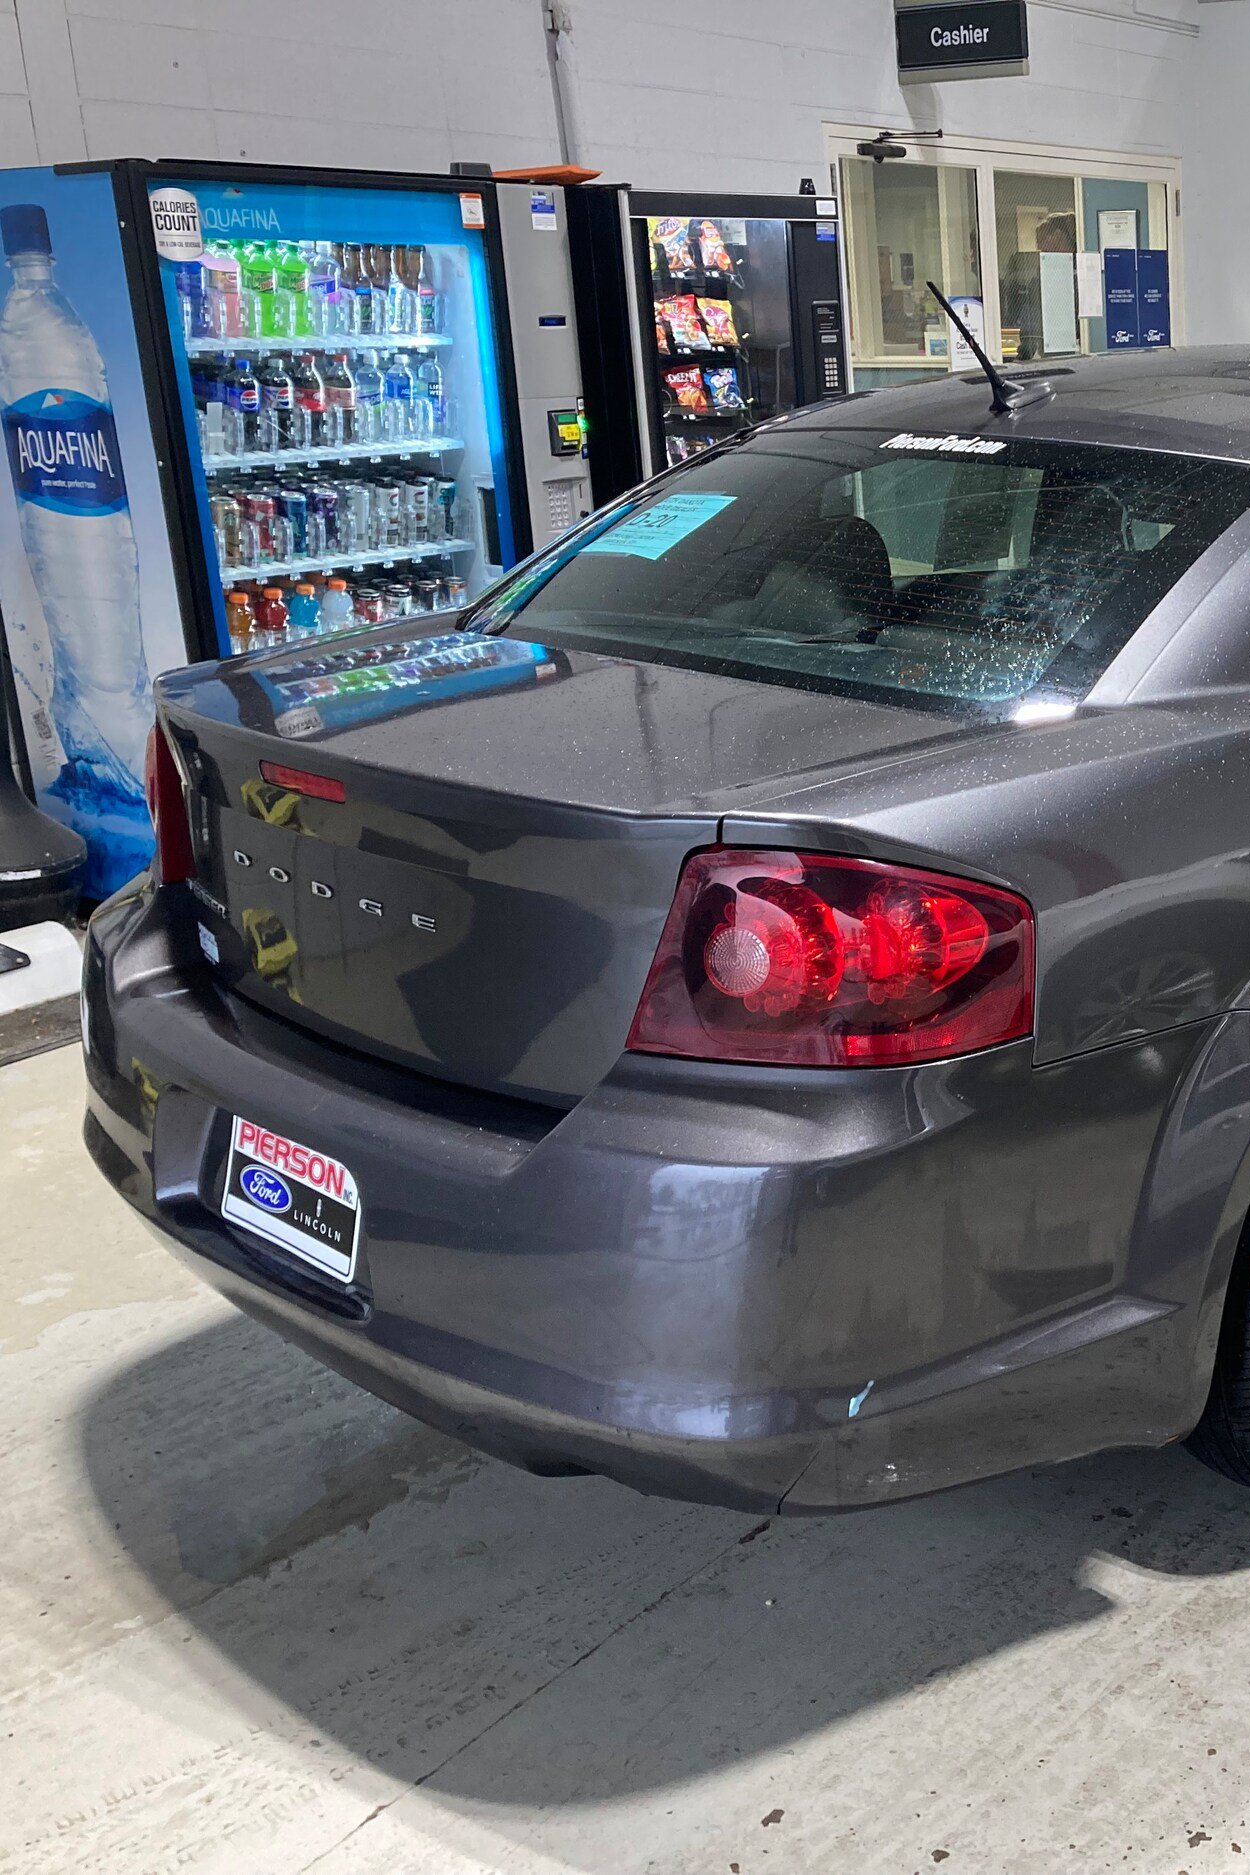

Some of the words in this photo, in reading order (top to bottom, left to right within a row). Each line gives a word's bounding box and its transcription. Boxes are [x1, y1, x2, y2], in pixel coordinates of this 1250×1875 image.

[930, 24, 989, 47] Cashier
[152, 201, 197, 214] CALORIES
[154, 214, 198, 231] COUNT
[1115, 330, 1130, 343] Ford
[1146, 329, 1161, 342] Ford
[18, 427, 115, 478] AQUAFINA
[879, 433, 1008, 455] PiersonFord.com
[234, 849, 437, 934] DODGE
[238, 1119, 346, 1198] PIERSON
[250, 1171, 281, 1206] Ford
[293, 1209, 342, 1243] LINCOLN
